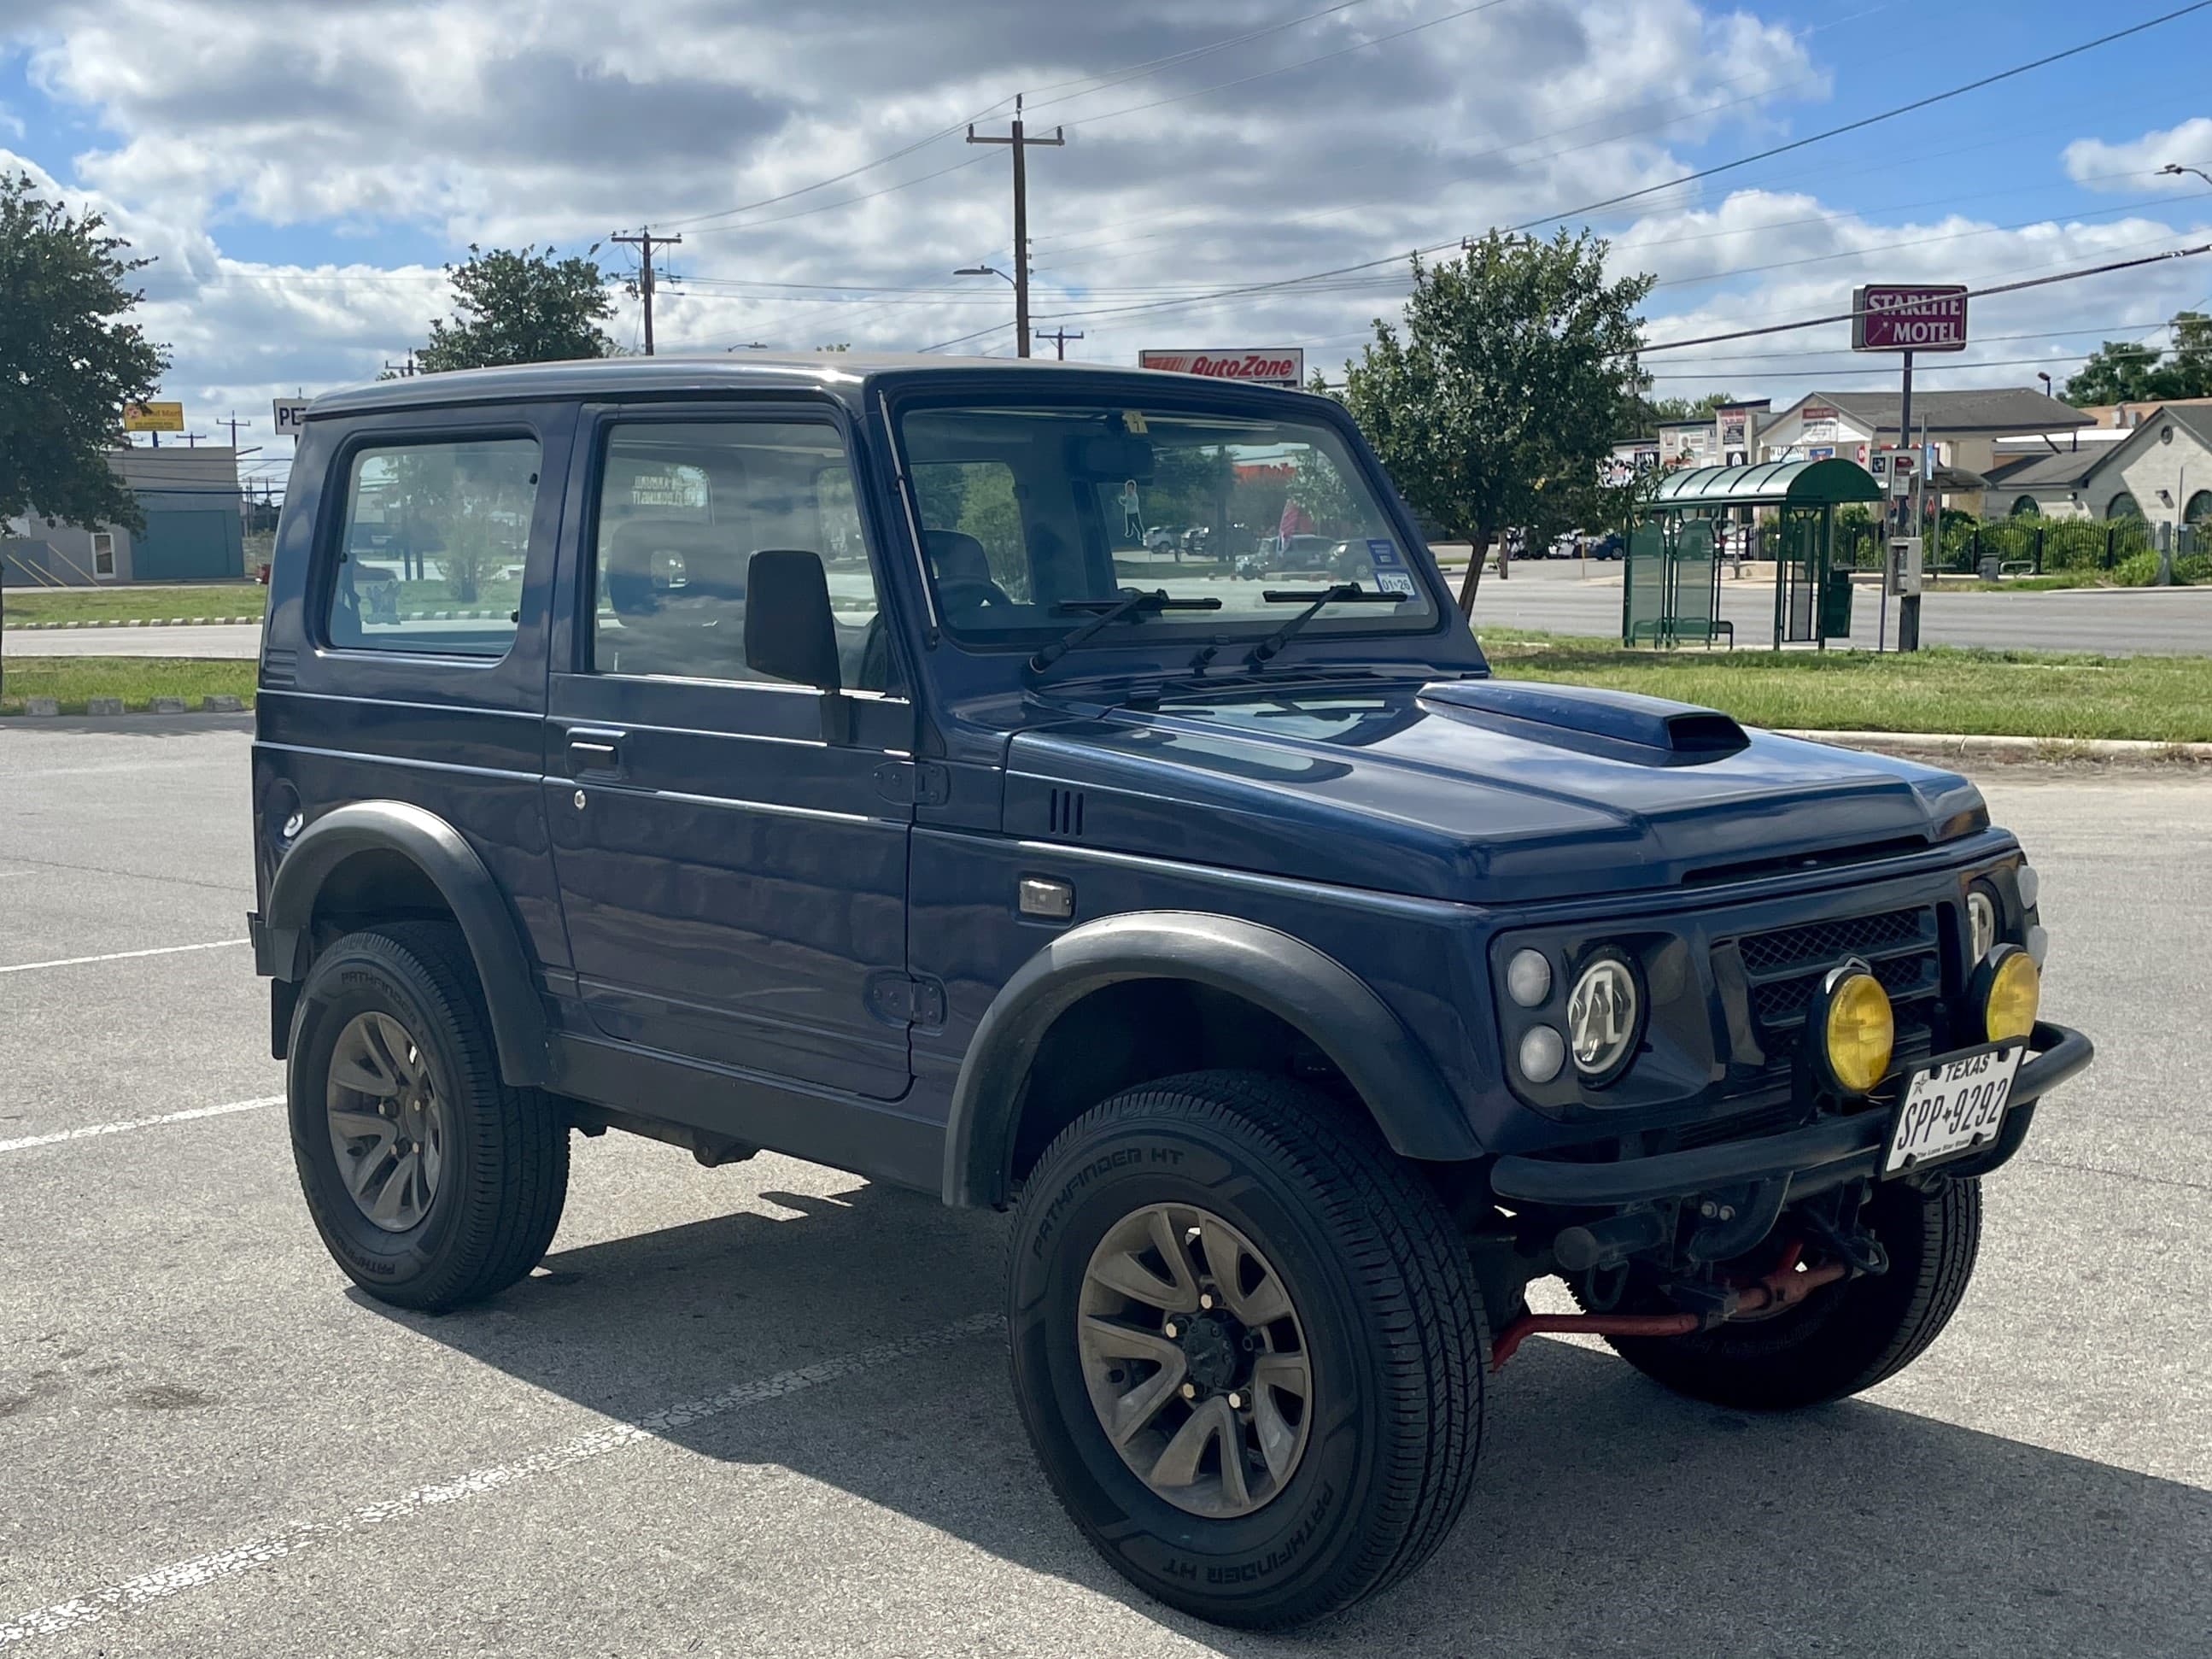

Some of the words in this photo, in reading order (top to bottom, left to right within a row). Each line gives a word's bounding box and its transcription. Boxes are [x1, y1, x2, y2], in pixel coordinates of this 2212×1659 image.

[1869, 295, 1961, 315] STARLITE
[1893, 322, 1959, 342] MOTEL
[1191, 355, 1293, 378] AutoZone
[279, 407, 307, 425] PE
[1382, 579, 1394, 590] 01
[1946, 1055, 1990, 1082] TEXAS
[1033, 1148, 1142, 1259] PATHFINDER
[1151, 1147, 1185, 1164] HT
[1206, 1480, 1335, 1585] PATHFINDER
[1162, 1557, 1197, 1582] HT
